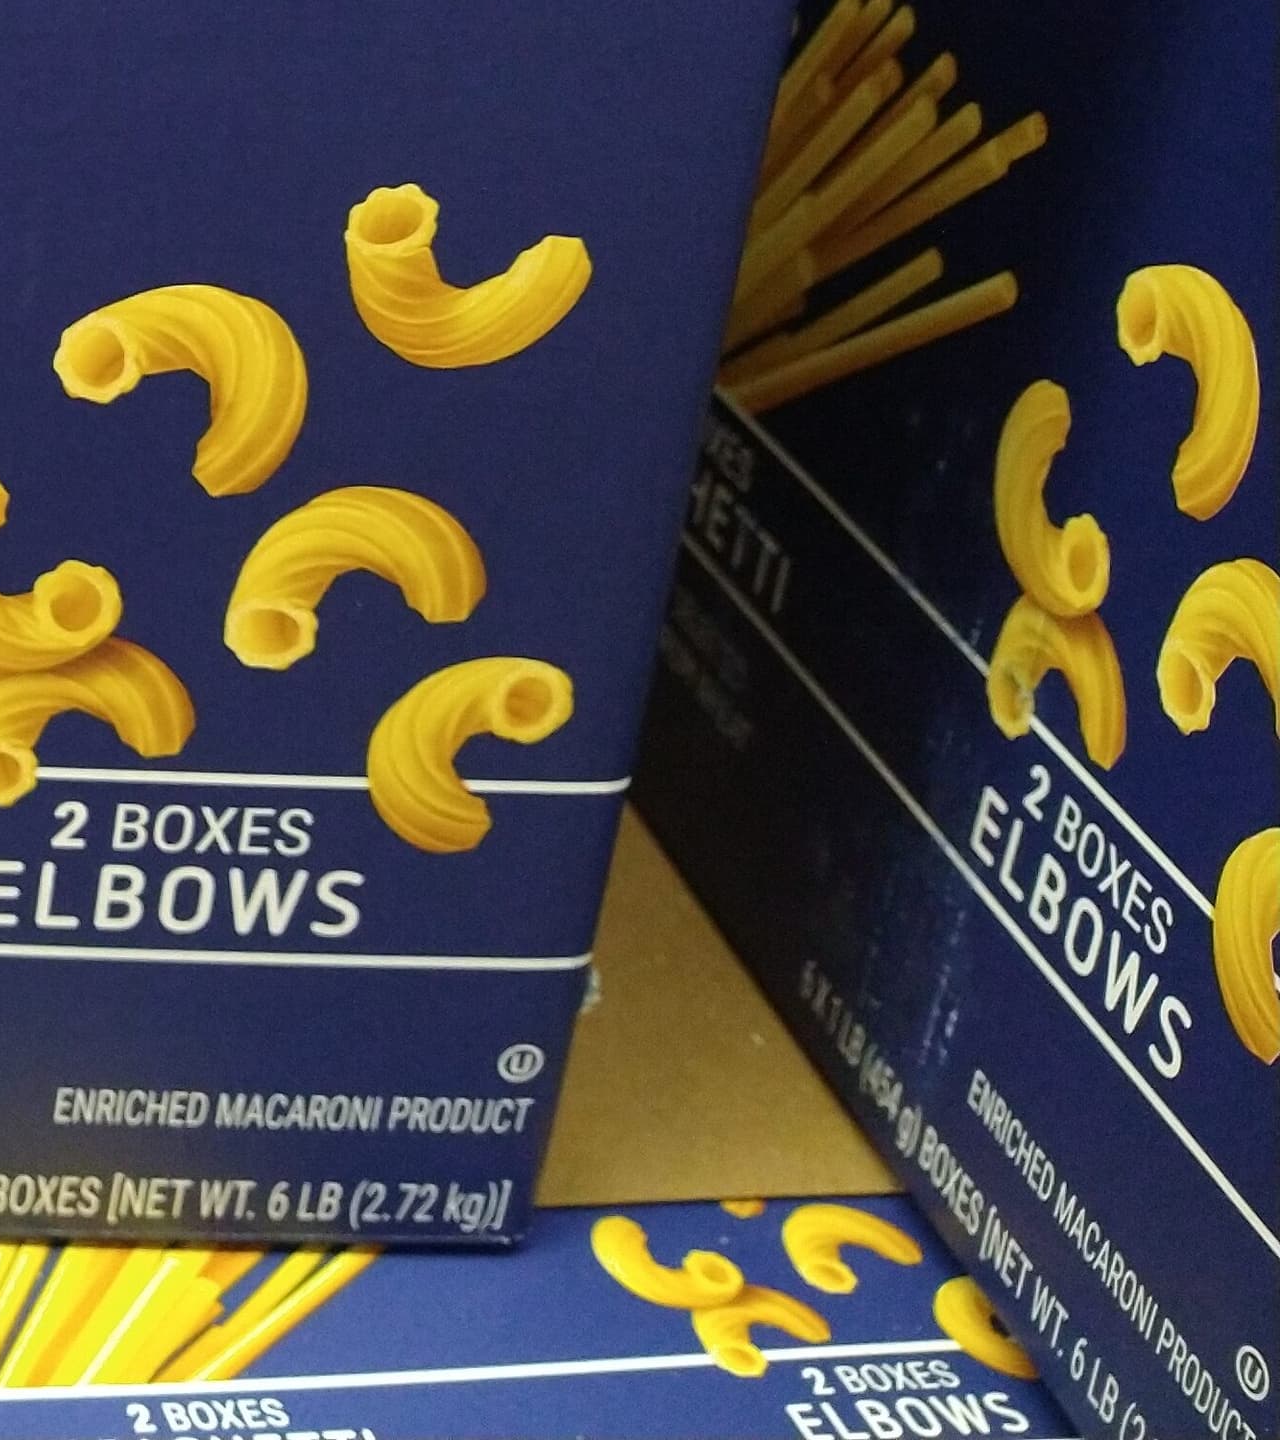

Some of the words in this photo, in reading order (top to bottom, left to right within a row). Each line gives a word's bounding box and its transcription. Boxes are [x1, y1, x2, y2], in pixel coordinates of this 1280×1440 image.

[50, 801, 89, 849] 2
[112, 803, 314, 857] BOXES
[1022, 764, 1052, 822] 2
[1053, 795, 1175, 954] BOXES
[970, 785, 1193, 1079] ELBOWS
[54, 1087, 209, 1128] ENRICHED
[215, 1092, 382, 1131] MACARONI
[388, 1097, 533, 1133] PRODUCT
[200, 1178, 257, 1220] WT.
[267, 1181, 290, 1221] 6
[296, 1181, 344, 1222] LB
[349, 1180, 439, 1231] (2.72
[967, 1068, 1055, 1202] ENRICHED
[1053, 1180, 1158, 1340] MACARONI
[918, 1125, 984, 1236] BOXES
[1031, 1276, 1069, 1358] WT.
[1070, 1338, 1088, 1381] 6
[1087, 1357, 1119, 1423] LB
[801, 1367, 836, 1396] 2
[835, 1360, 960, 1393] BOXES
[126, 1403, 157, 1433] 2
[161, 1398, 289, 1432] BOXES
[785, 1391, 1030, 1440] ELBOWS
